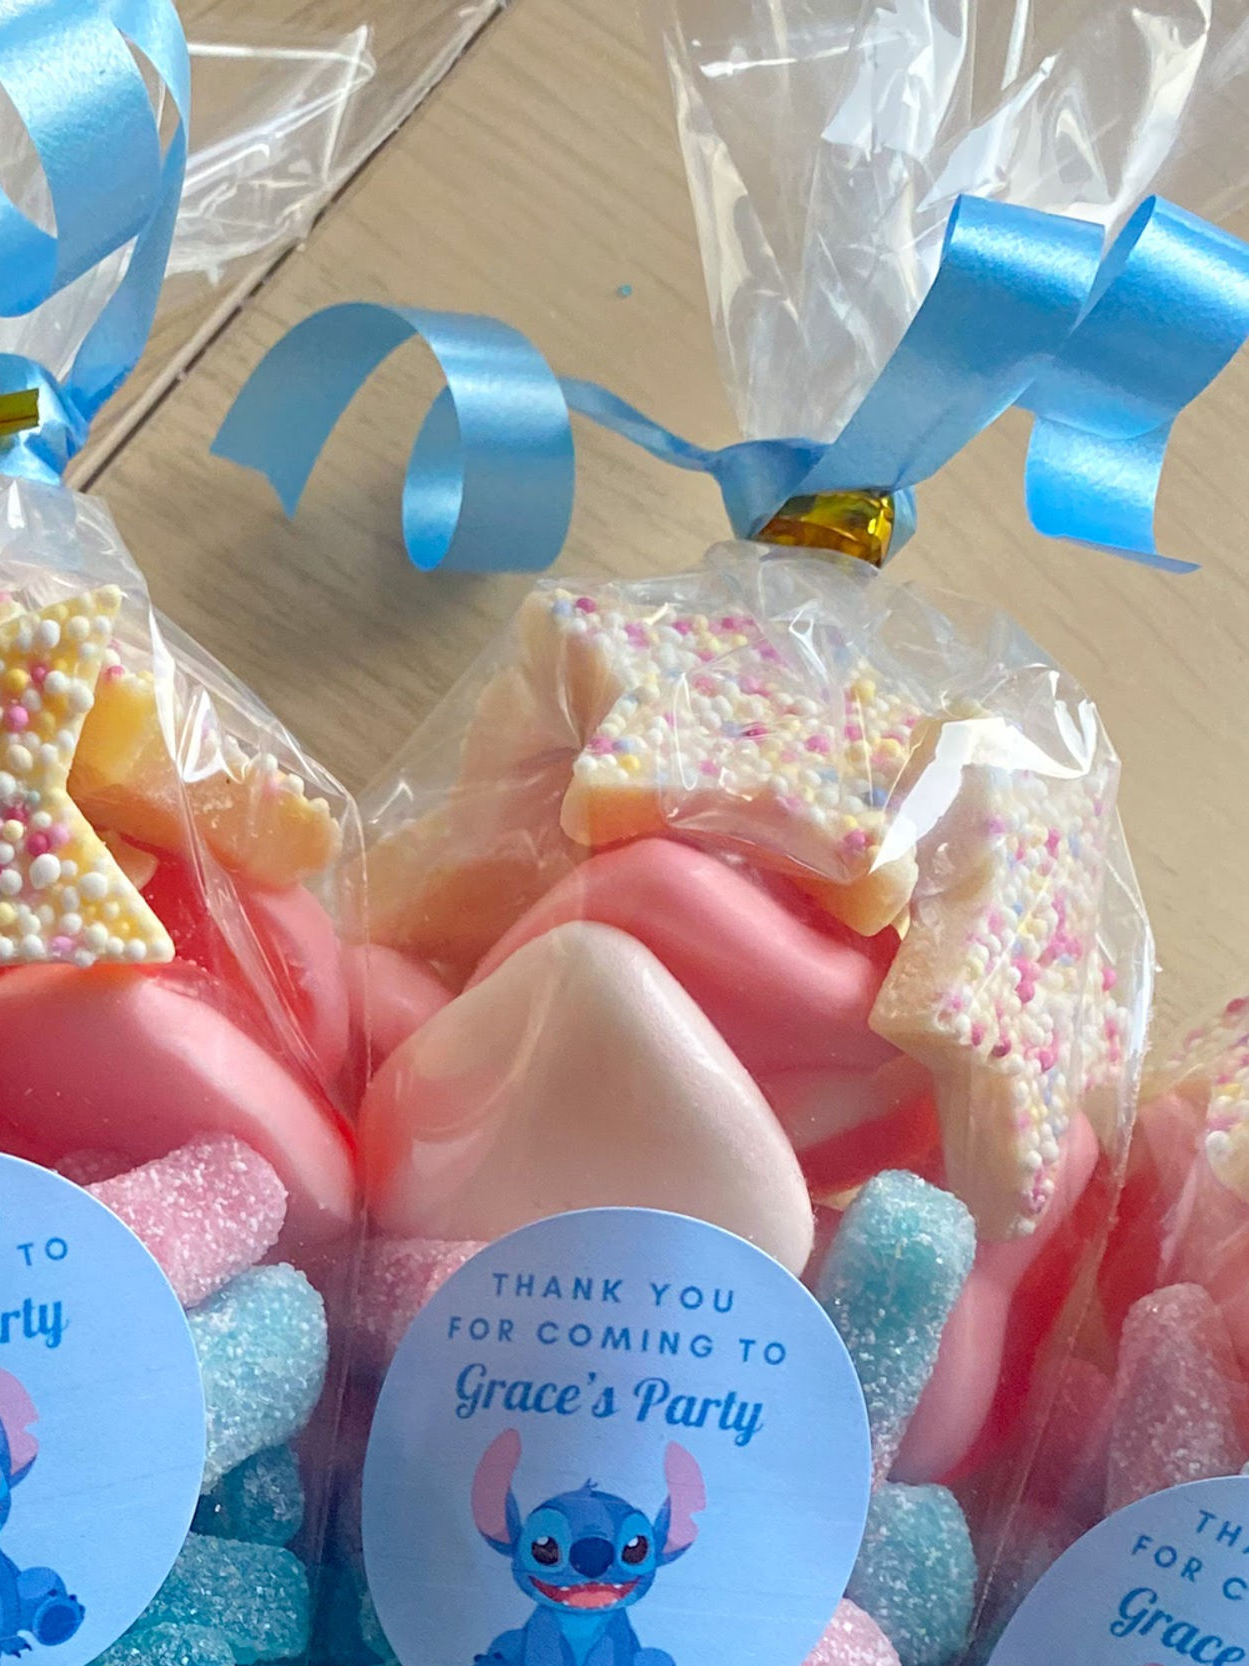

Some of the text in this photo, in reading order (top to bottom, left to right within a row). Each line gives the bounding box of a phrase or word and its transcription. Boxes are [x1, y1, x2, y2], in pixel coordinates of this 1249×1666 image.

[17, 1237, 69, 1267] TO
[492, 1273, 734, 1314] THANK YOU
[448, 1316, 787, 1366] FOR COMING TO
[455, 1362, 764, 1447] Grace's Party
[1132, 1535, 1203, 1582] FOR
